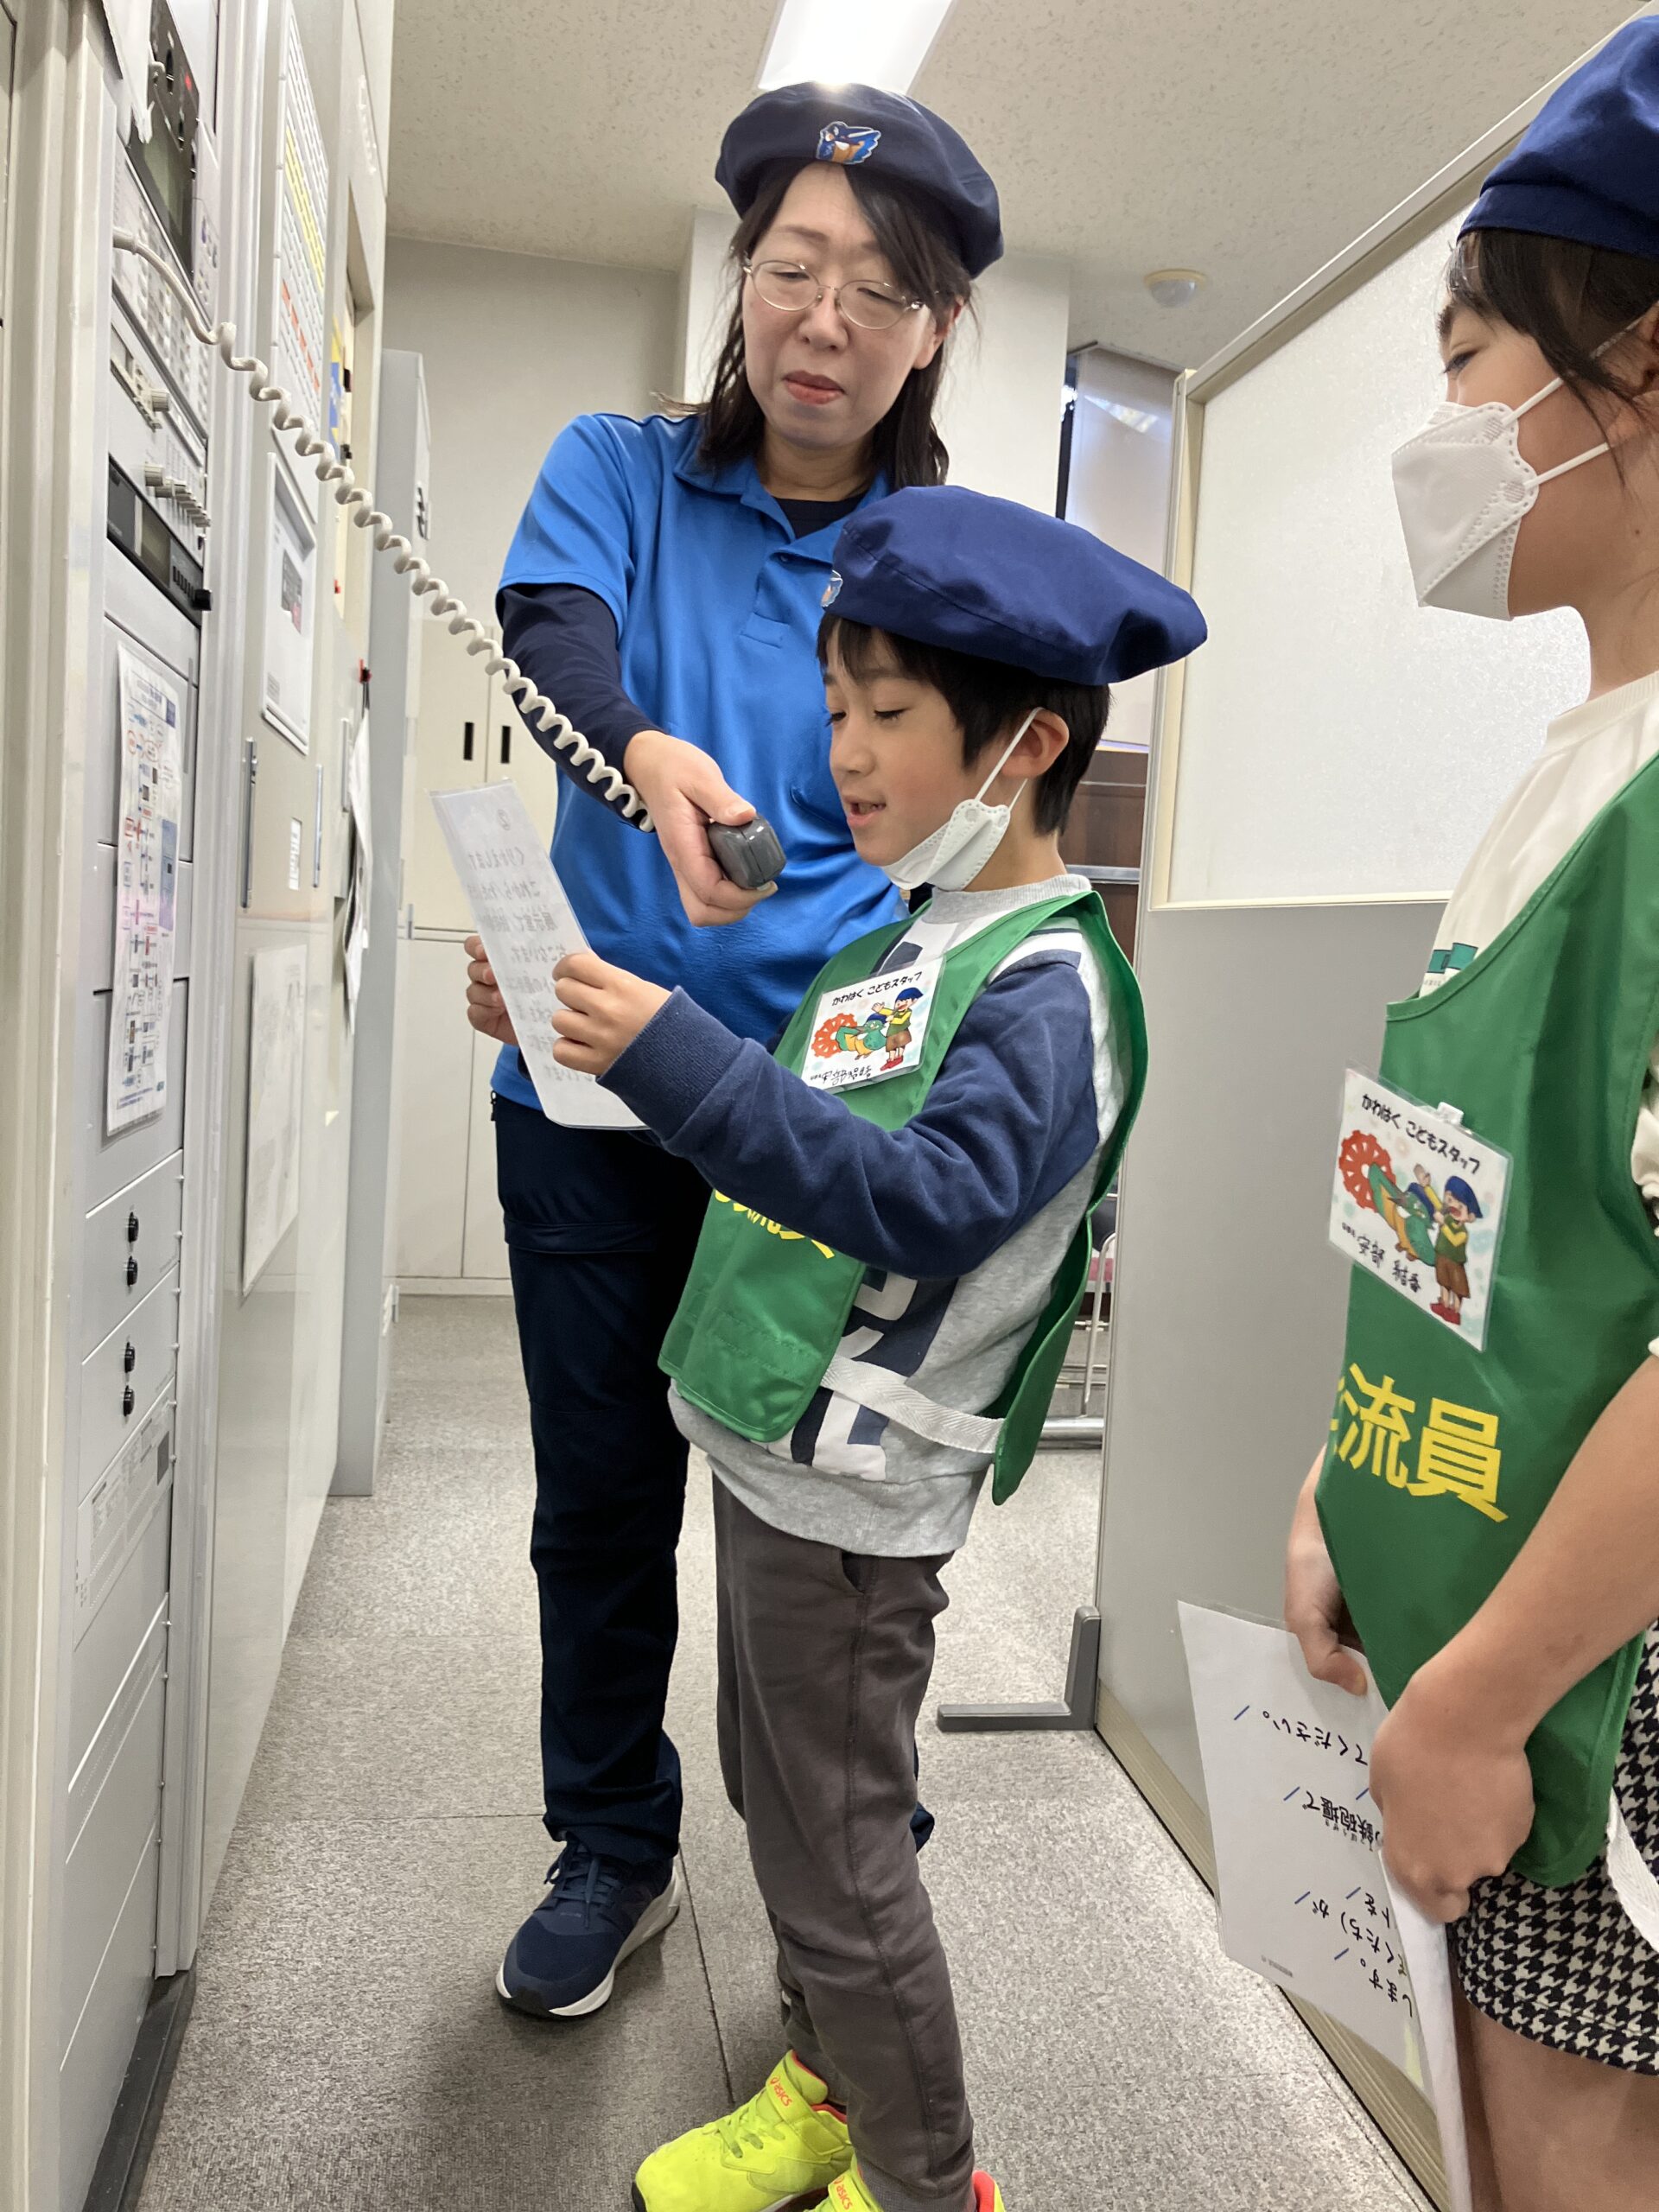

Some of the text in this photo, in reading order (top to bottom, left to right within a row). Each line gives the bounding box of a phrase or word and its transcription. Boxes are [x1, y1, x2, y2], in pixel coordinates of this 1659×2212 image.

[831, 970, 923, 1007] かわはく こどもスタッフ
[1361, 1093, 1481, 1175] かわはく こどもスタッフ
[1329, 1362, 1509, 1523] 流員
[1262, 1710, 1369, 1766] てください。
[1359, 1957, 1413, 2018] します。
